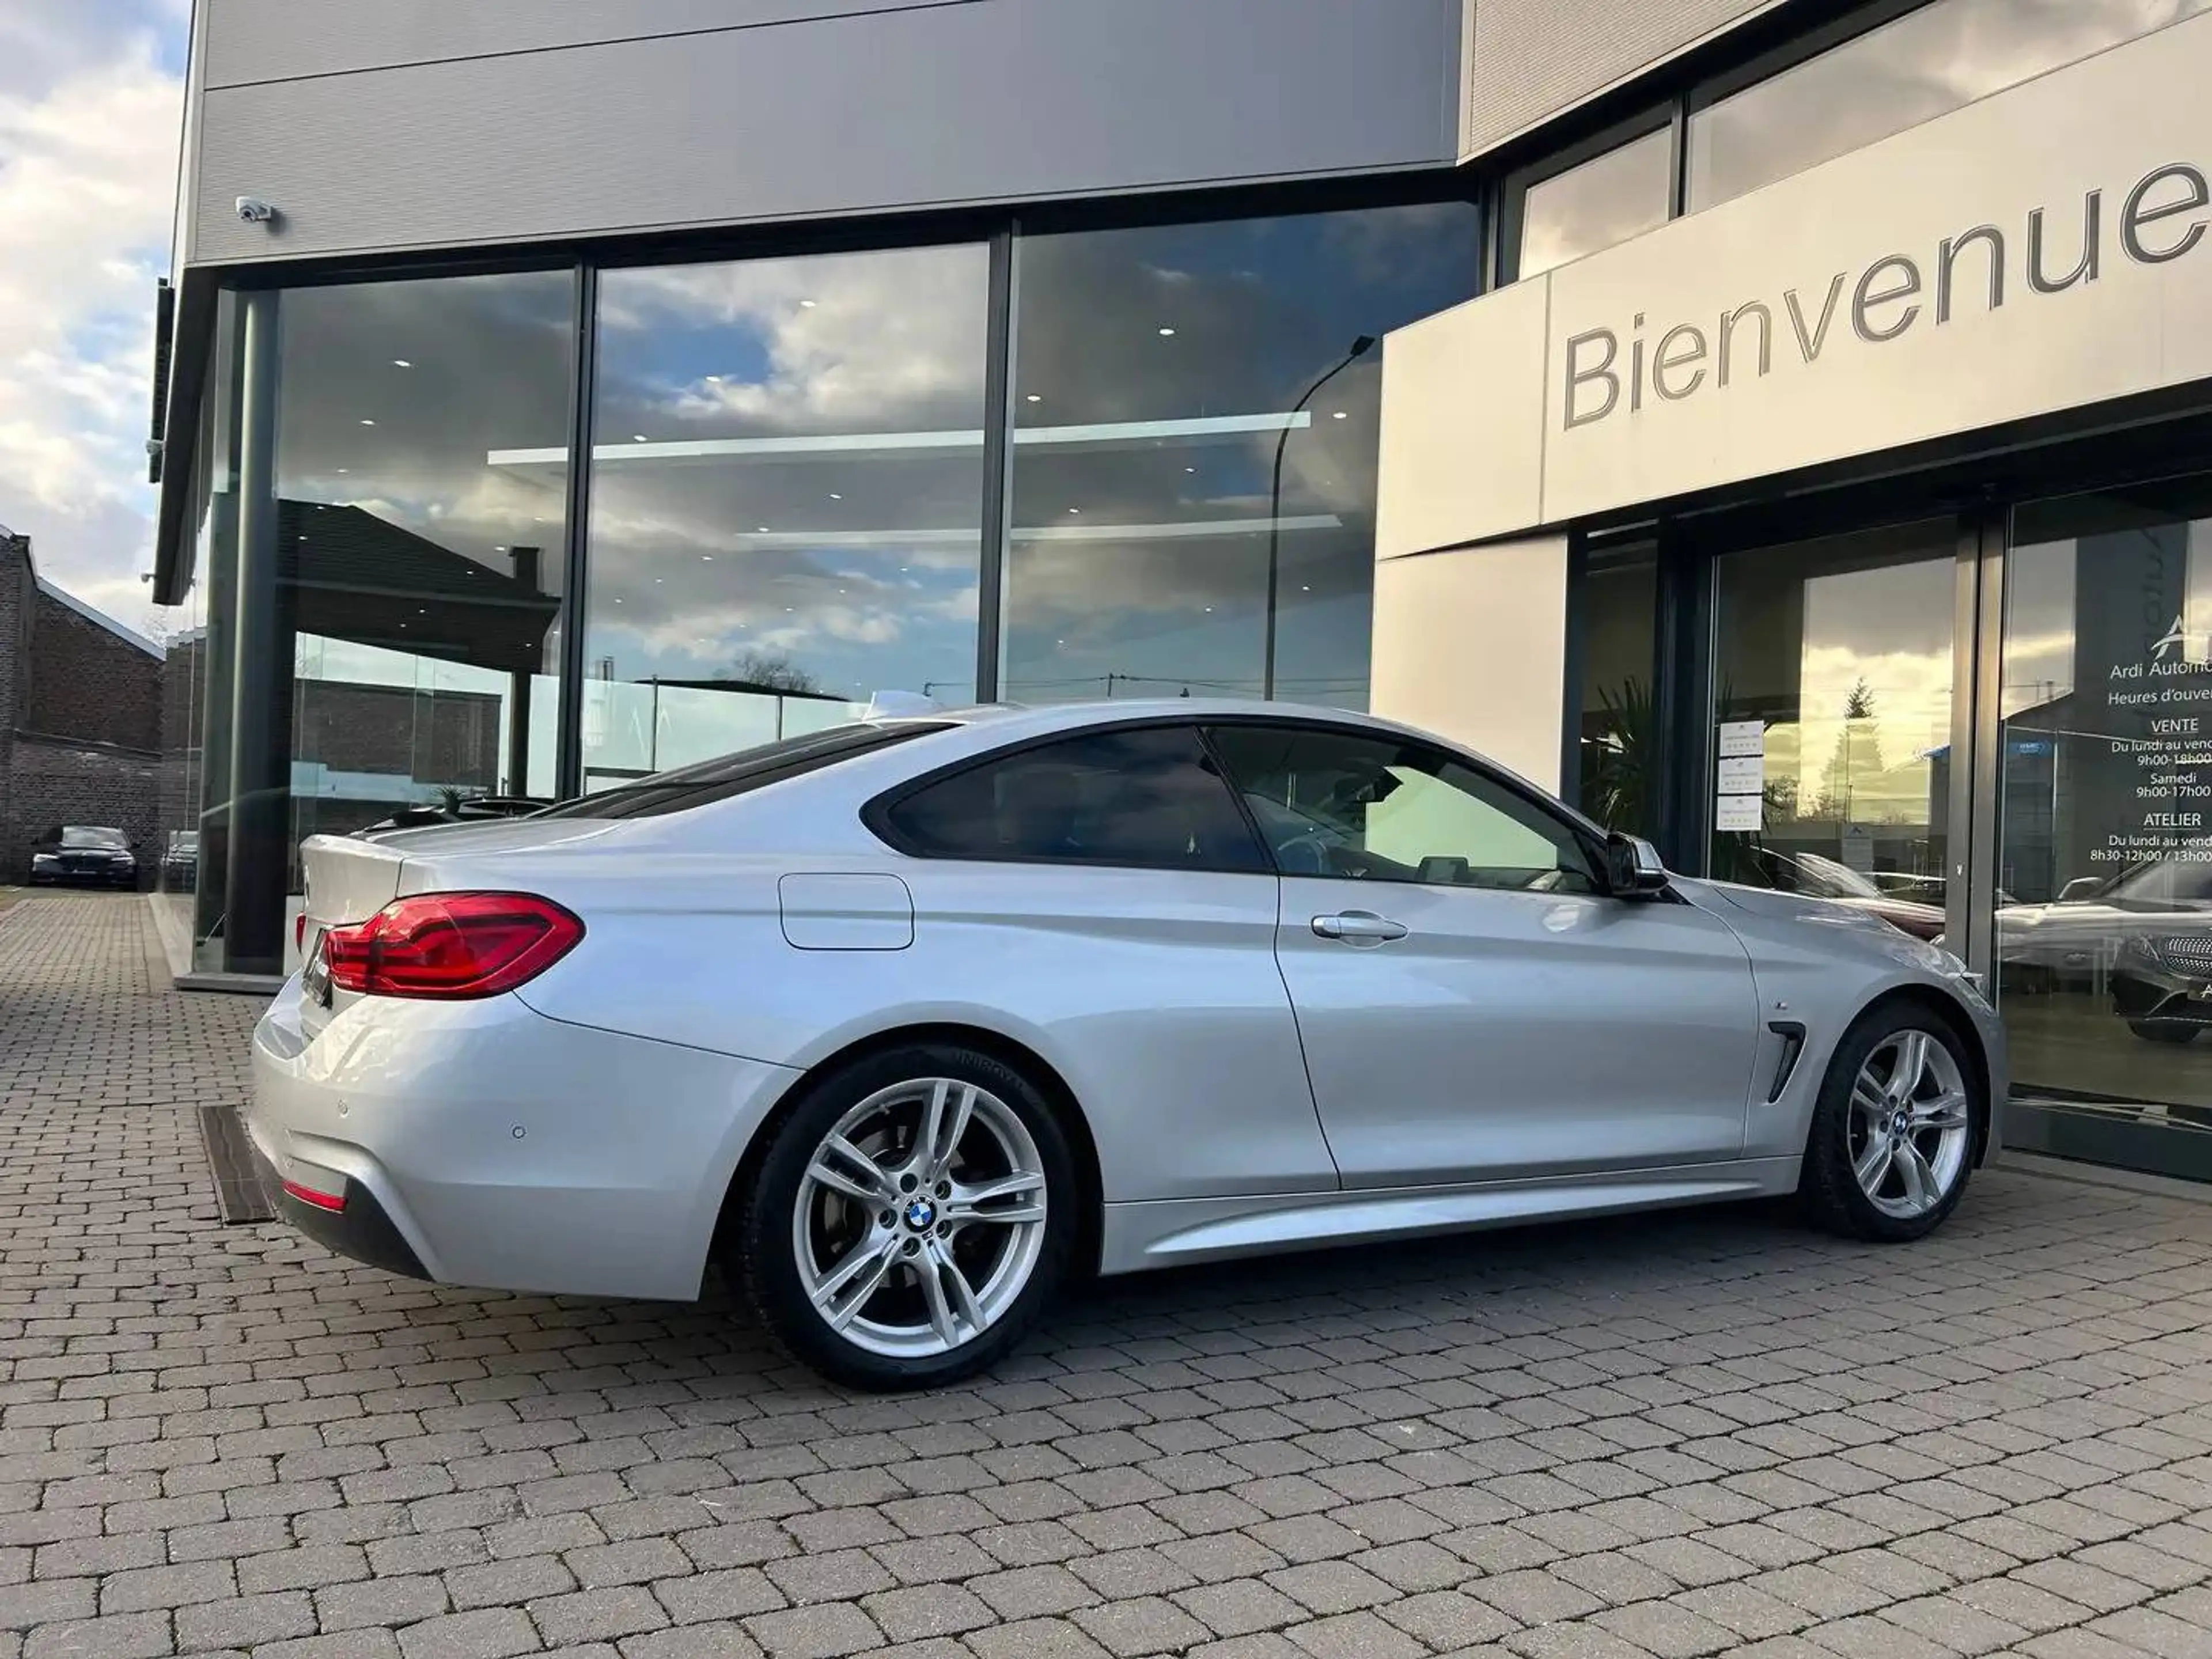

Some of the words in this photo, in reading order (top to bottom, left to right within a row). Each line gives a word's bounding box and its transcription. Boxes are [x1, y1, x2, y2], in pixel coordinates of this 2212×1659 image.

[1563, 162, 2211, 431] Bienvenue
[2110, 663, 2142, 679] Ardi
[2108, 692, 2158, 705] Heures
[2152, 718, 2199, 733] VENTE
[2112, 741, 2128, 753] Du
[2132, 740, 2162, 751] lundi
[2166, 741, 2180, 749] au
[2150, 772, 2196, 784] Samedi
[2136, 786, 2211, 797] 9h00-17h00
[2143, 812, 2201, 826] ATELIER
[2109, 835, 2126, 846] Du
[2129, 835, 2160, 846] lundi
[2162, 836, 2178, 846] au
